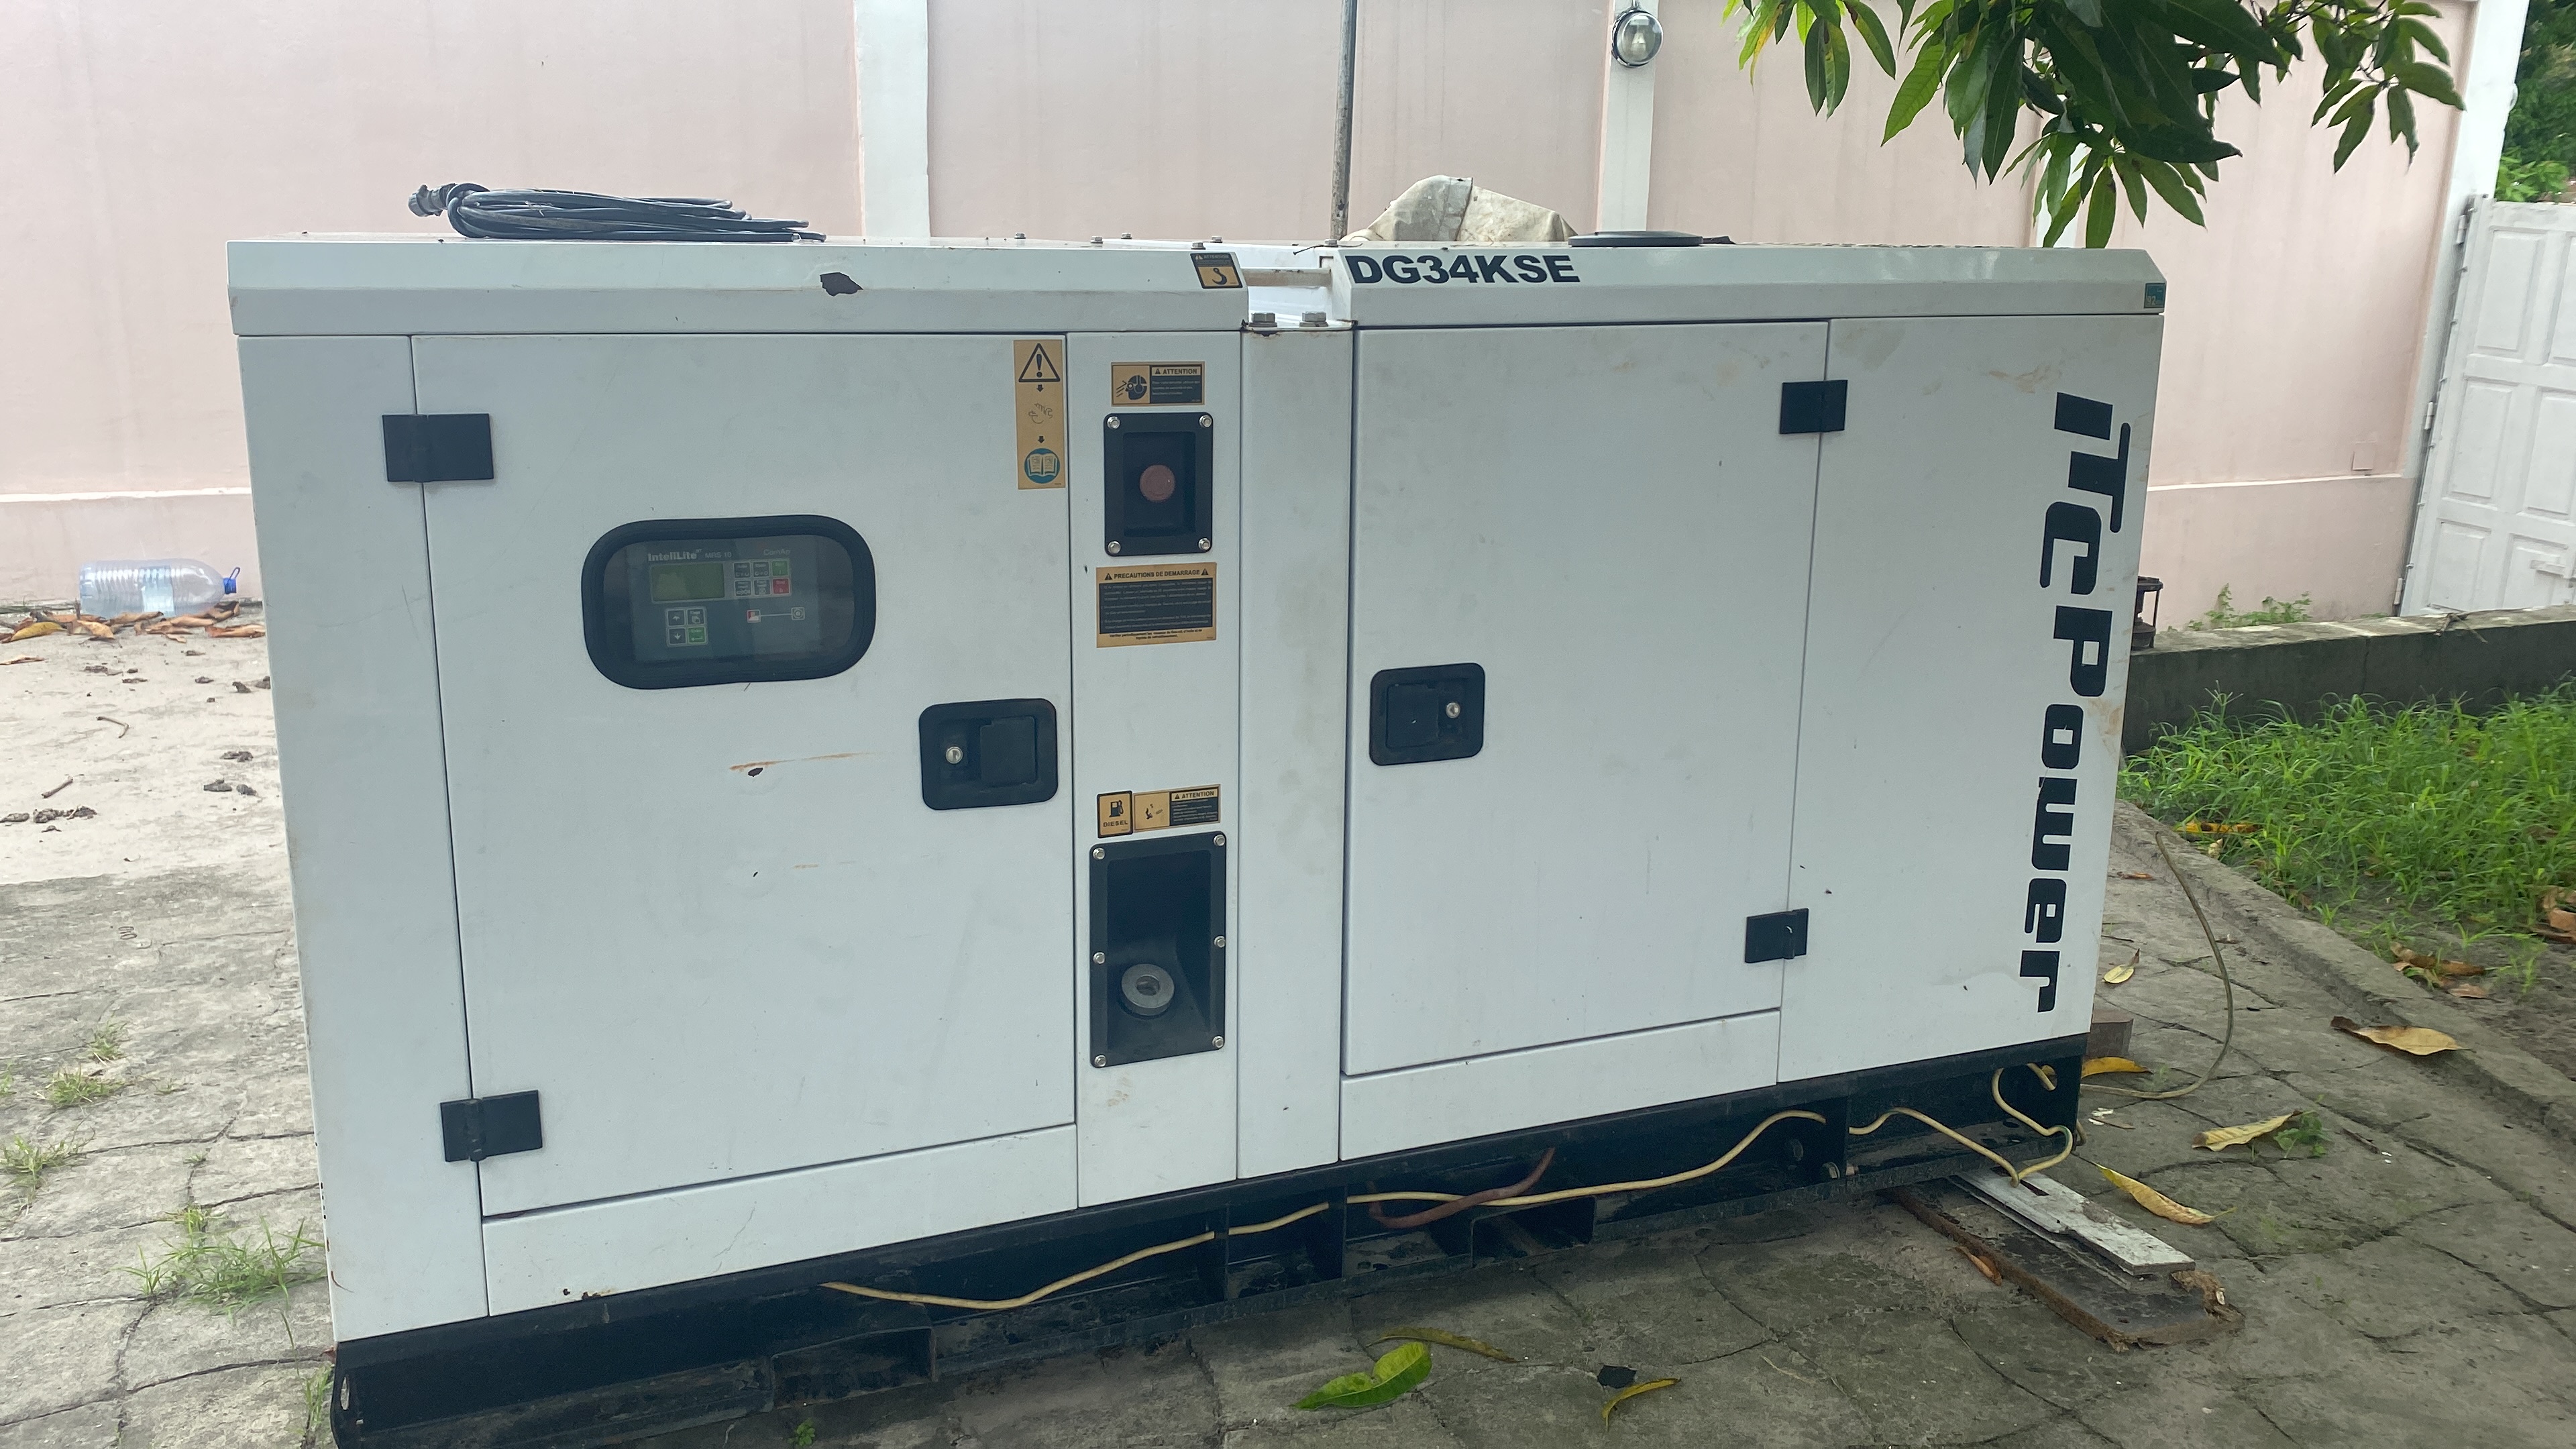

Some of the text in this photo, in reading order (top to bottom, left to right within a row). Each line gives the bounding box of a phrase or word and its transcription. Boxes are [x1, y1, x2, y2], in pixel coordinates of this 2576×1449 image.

[1344, 254, 1581, 284] DG34KSE
[1114, 572, 1155, 580] PRECAUTIONS
[1181, 790, 1214, 799] ATTENTION
[1103, 820, 1128, 828] DIESEL
